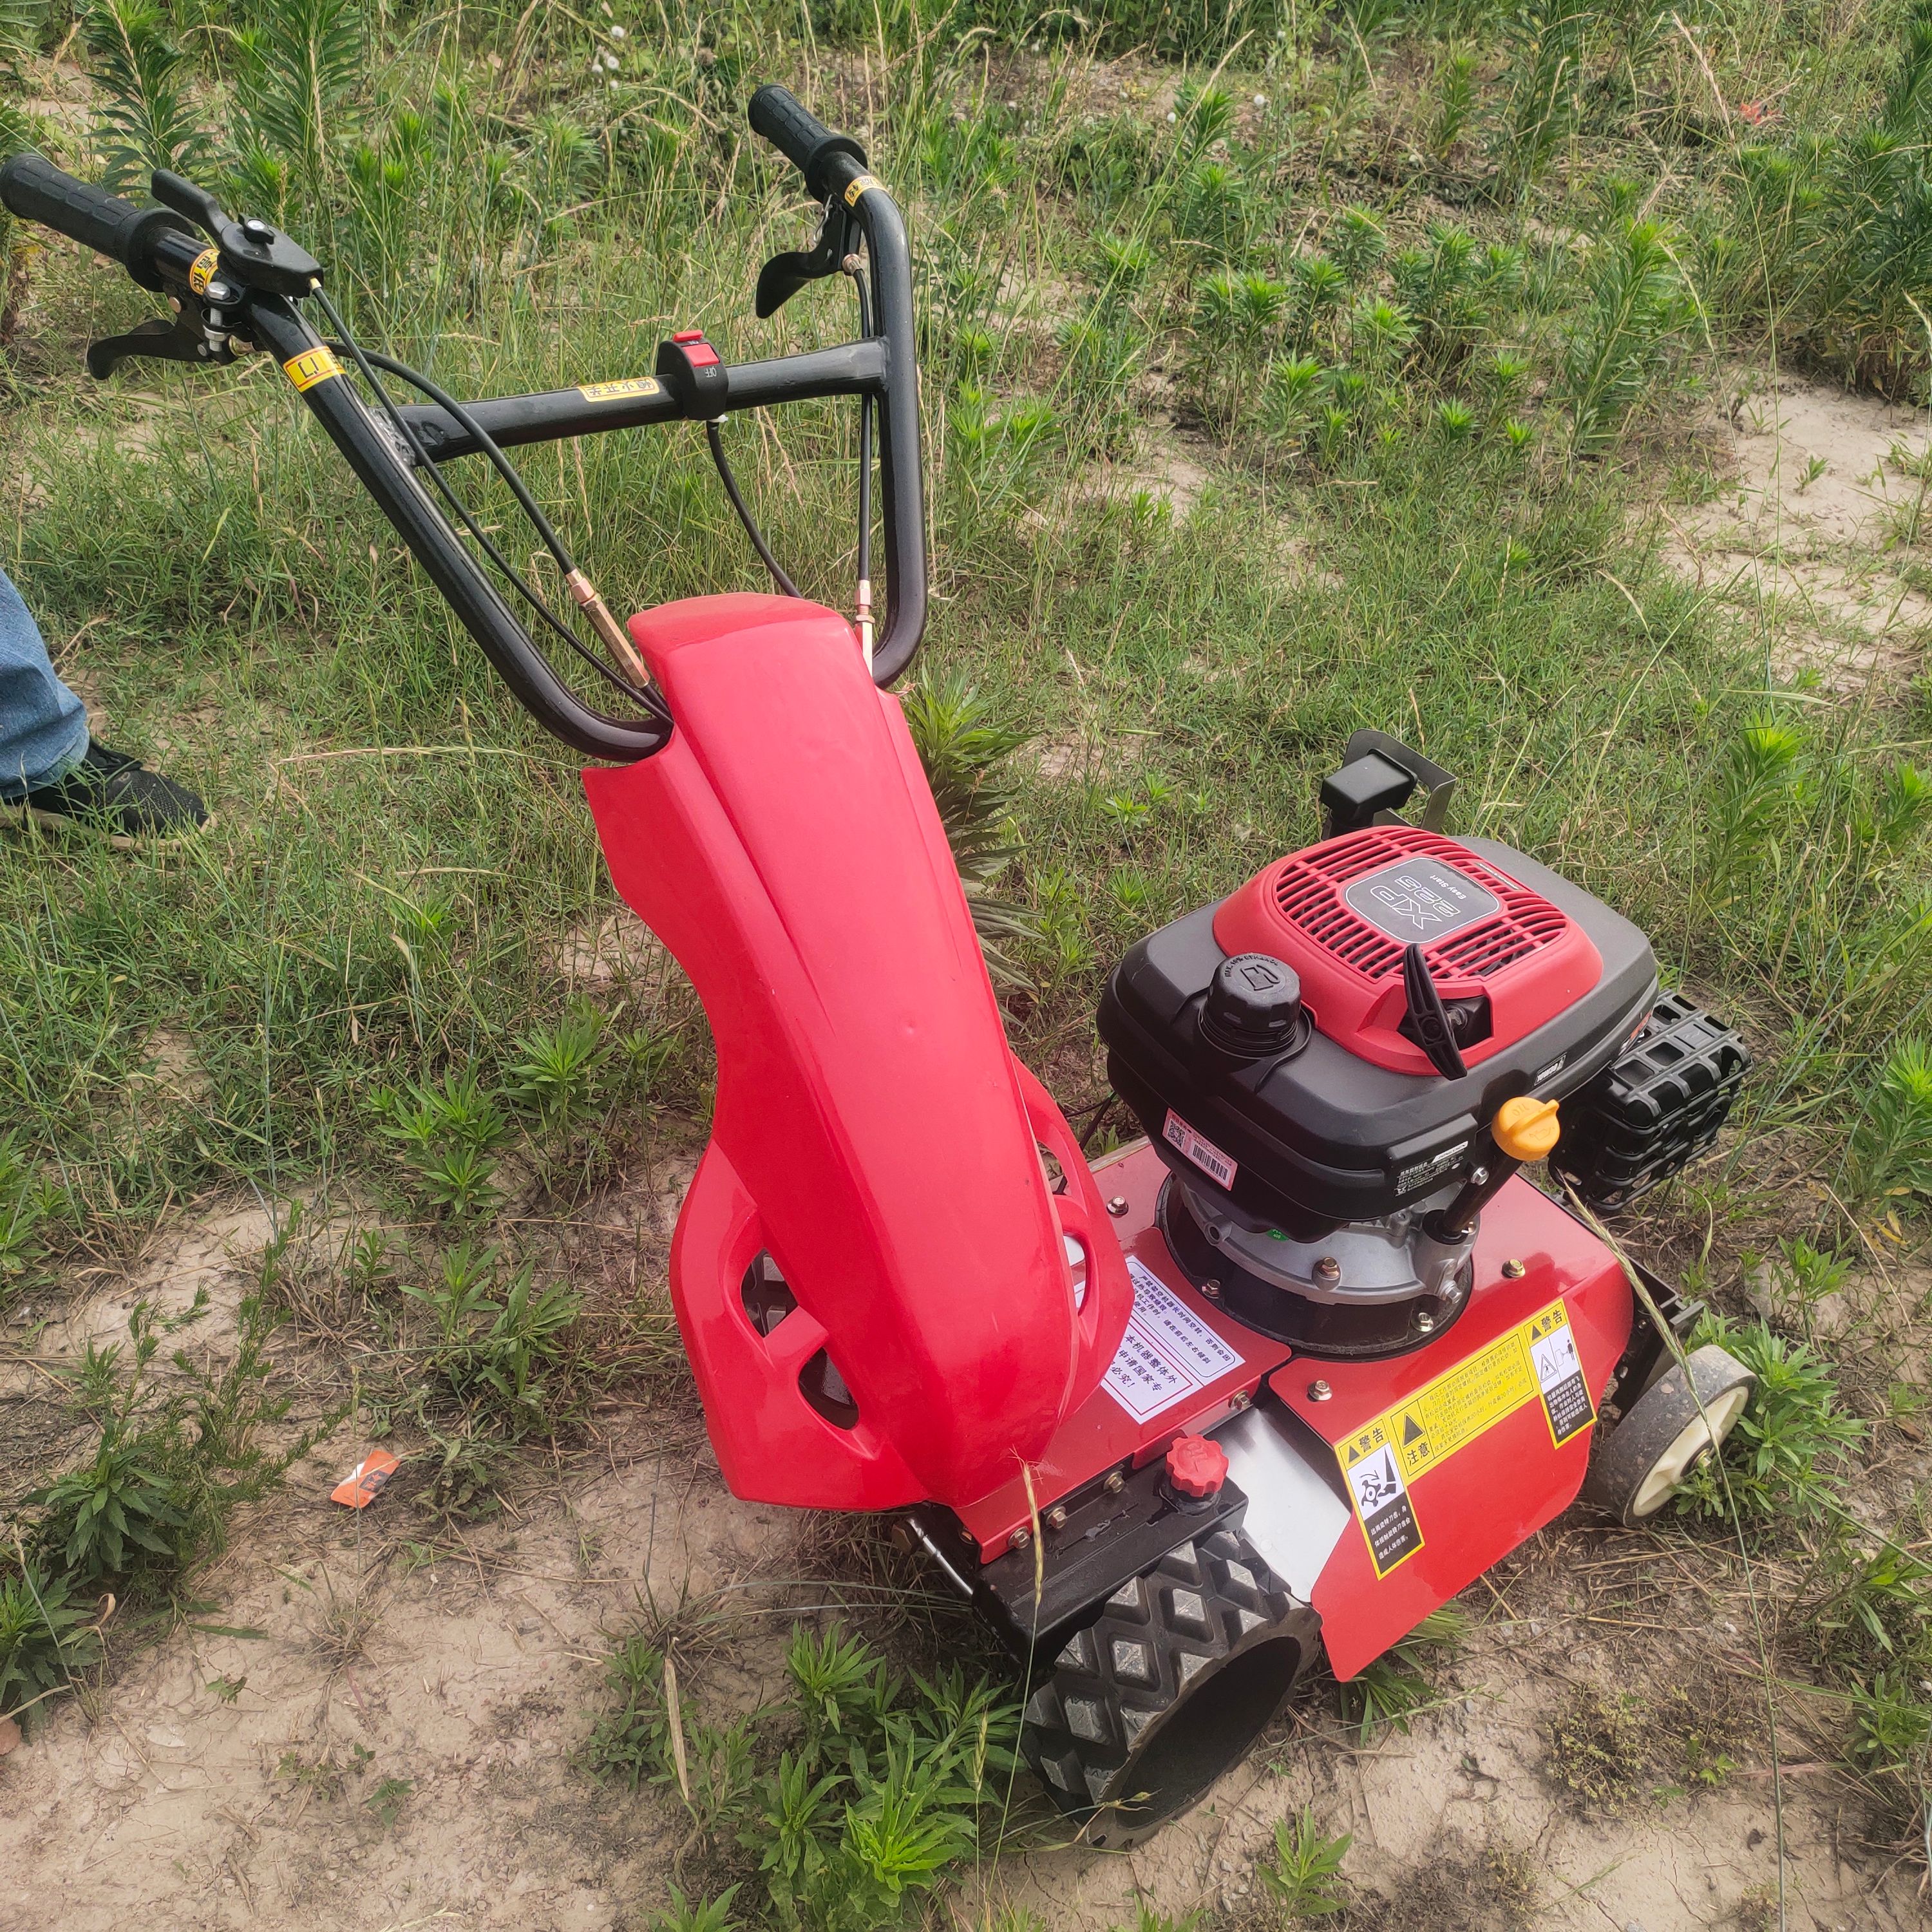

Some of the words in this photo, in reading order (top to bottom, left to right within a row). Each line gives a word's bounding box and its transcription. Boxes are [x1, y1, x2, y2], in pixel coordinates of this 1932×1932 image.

[704, 366, 717, 378] OFF
[587, 379, 652, 396] 熄火开关
[1429, 875, 1449, 888] Start
[1449, 886, 1467, 900] Easy
[1370, 886, 1442, 930] XP
[1394, 875, 1461, 917] 225
[1512, 1103, 1530, 1116] OIL
[1540, 1309, 1562, 1332] 警告
[1117, 1345, 1162, 1392] 申请国家专
[1124, 1334, 1178, 1385] 本机器整体外
[1358, 1426, 1384, 1453] 警告
[1406, 1441, 1430, 1466] 注意
